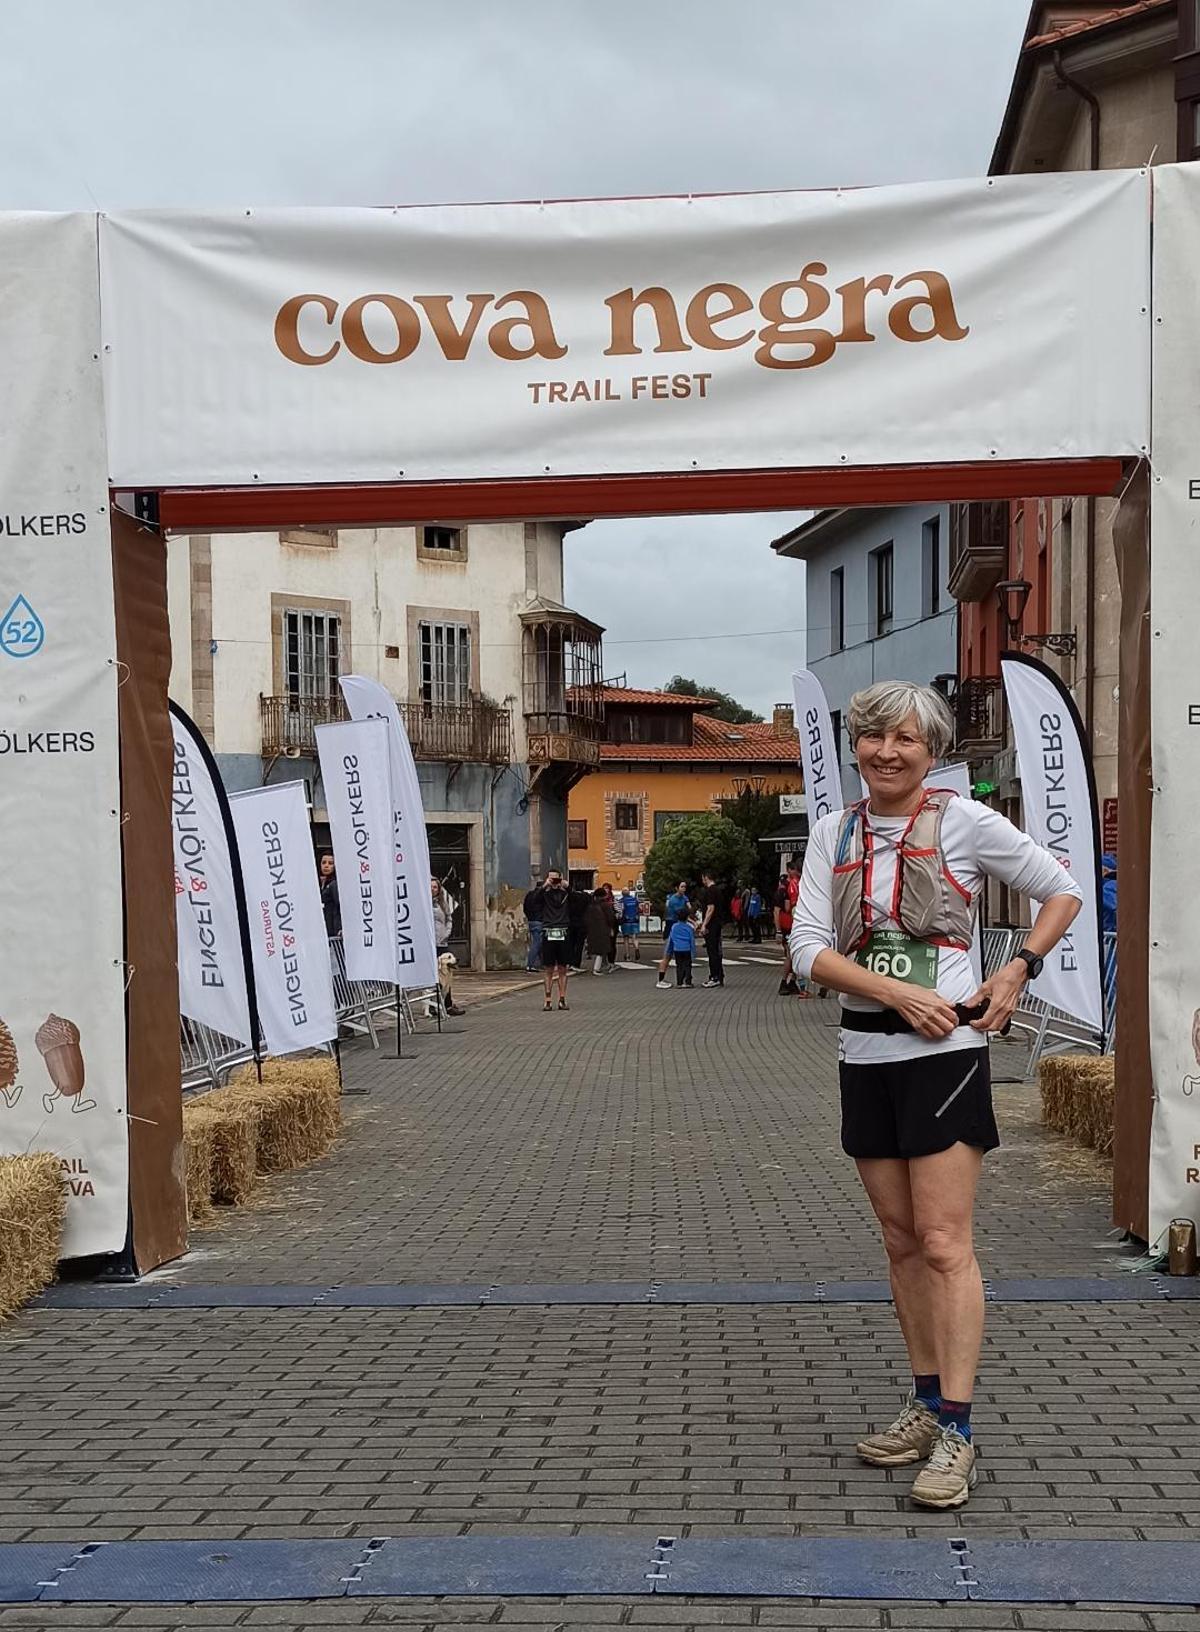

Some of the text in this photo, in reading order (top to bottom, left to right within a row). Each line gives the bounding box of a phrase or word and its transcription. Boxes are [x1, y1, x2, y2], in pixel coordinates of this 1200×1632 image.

[274, 261, 970, 370] cova negra
[527, 372, 712, 404] TRAIL FEST
[0, 512, 87, 536] LKERS
[6, 620, 38, 644] 52
[865, 952, 912, 978] 160
